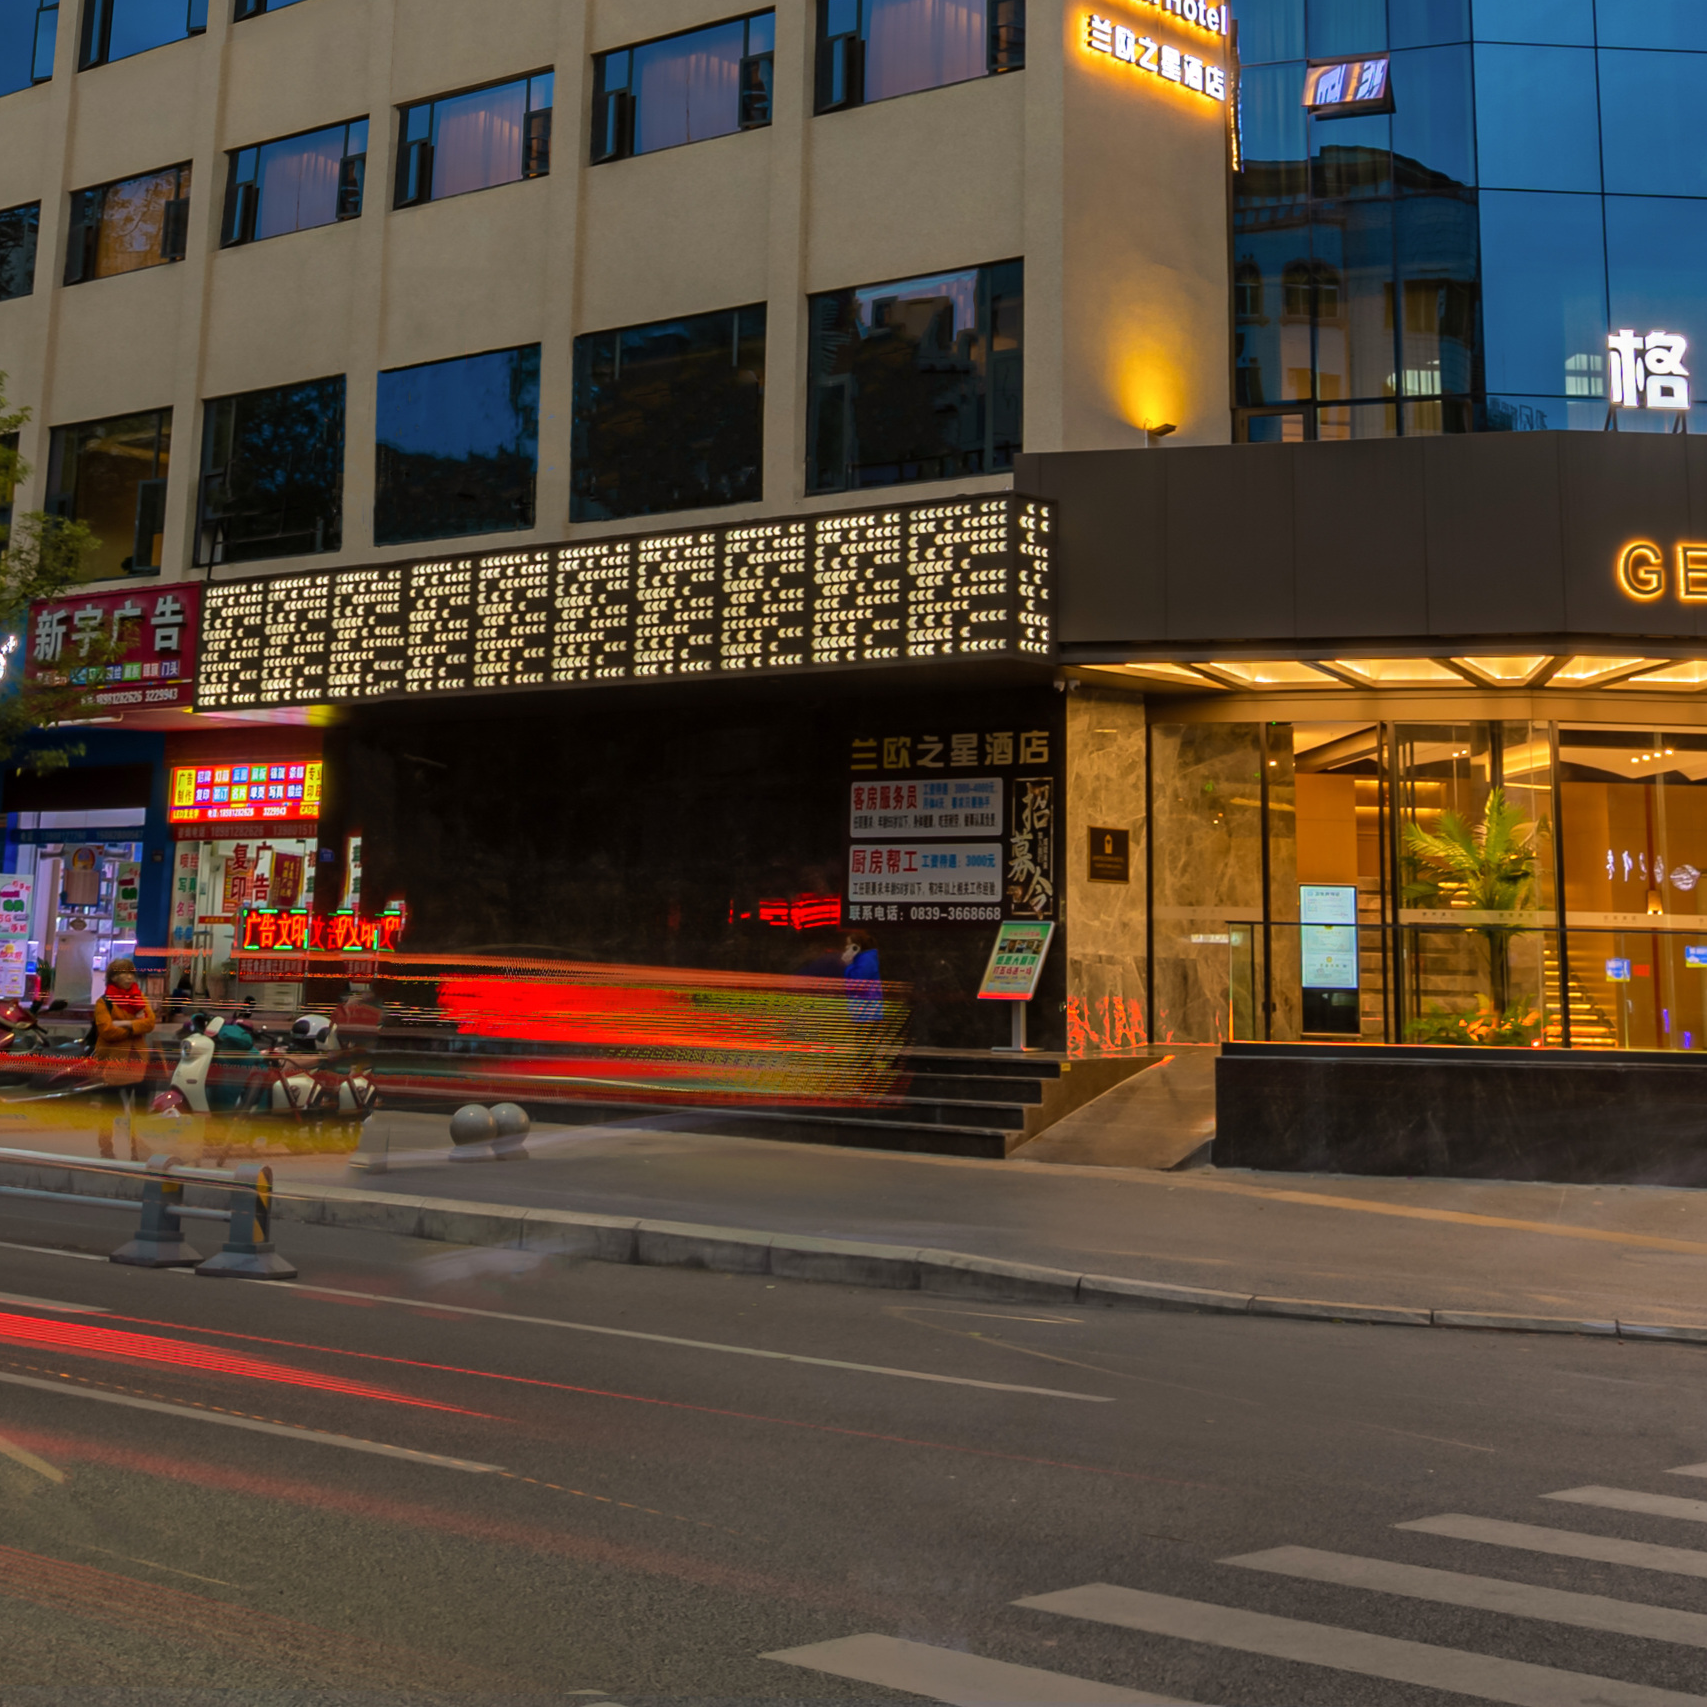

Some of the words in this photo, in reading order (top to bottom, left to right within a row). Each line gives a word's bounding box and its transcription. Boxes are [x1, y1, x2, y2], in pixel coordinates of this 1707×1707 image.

[1088, 13, 1226, 101] 兰欧之星酒店
[33, 594, 184, 661] 新宇广告
[850, 729, 1050, 770] 兰欧之星酒店
[853, 784, 917, 811] 客房服务员
[231, 842, 249, 903] 复印
[253, 841, 273, 902] 广告
[852, 848, 918, 875] 厨房帮工
[1007, 781, 1054, 920] 招募令
